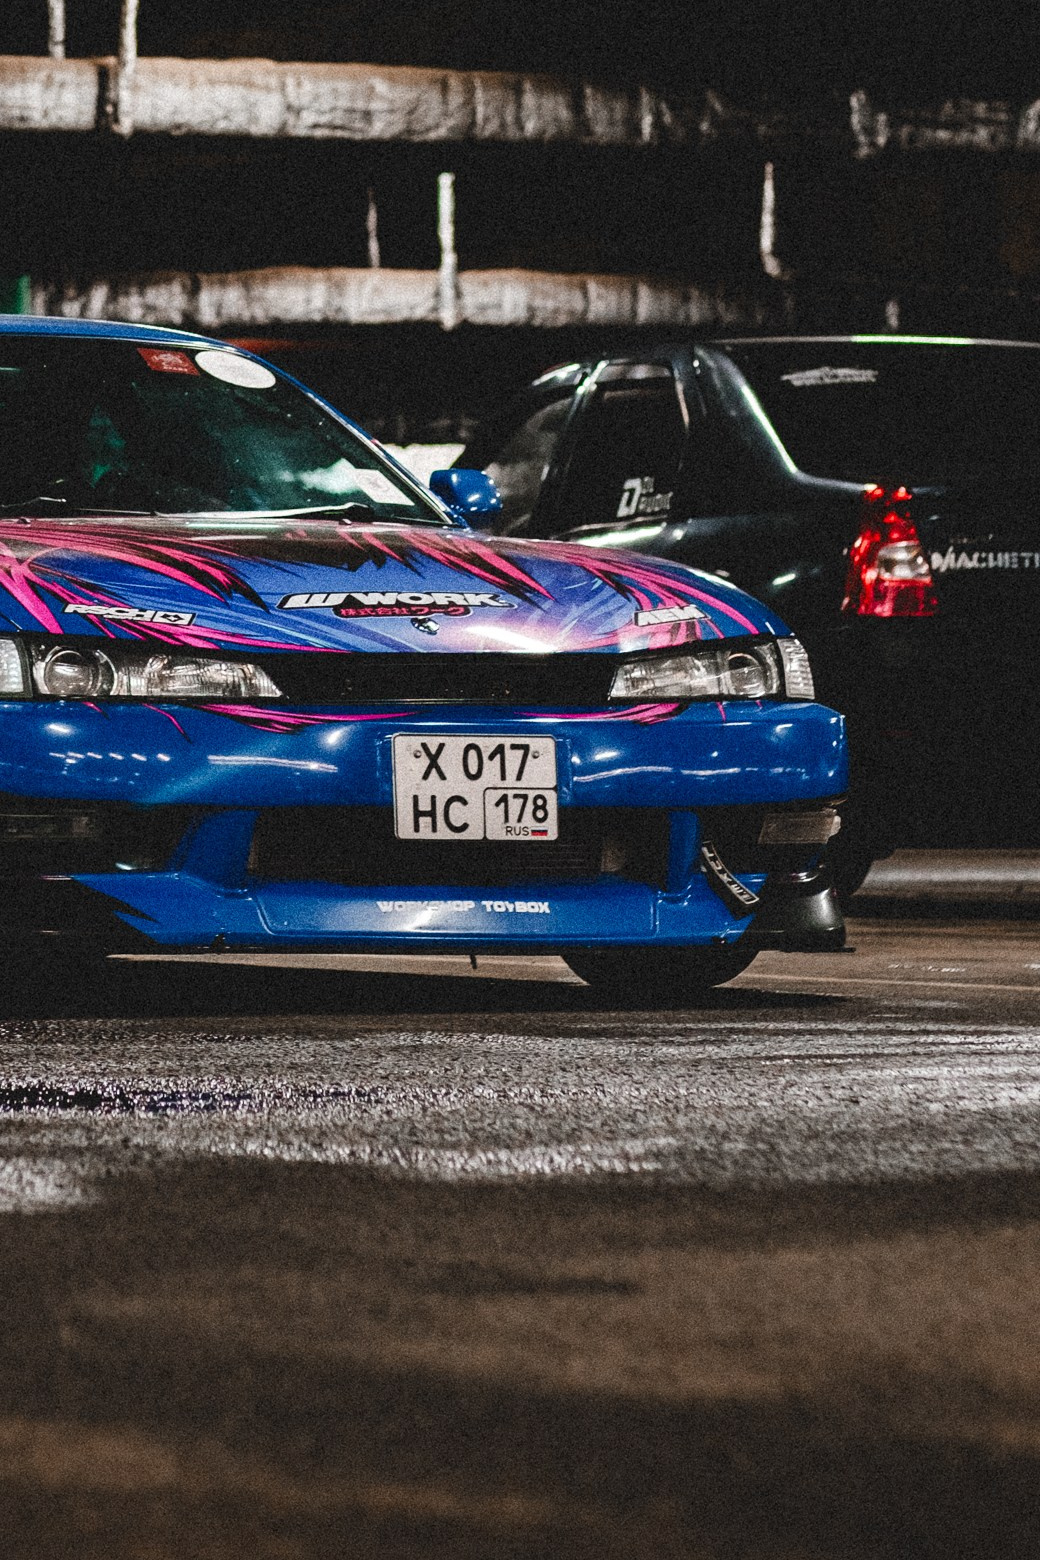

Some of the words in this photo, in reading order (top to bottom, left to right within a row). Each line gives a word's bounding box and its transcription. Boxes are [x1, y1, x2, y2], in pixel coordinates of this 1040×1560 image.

[420, 742, 447, 781] X
[462, 742, 531, 781] 017
[412, 794, 470, 833] HC
[494, 793, 549, 824] 178
[505, 826, 530, 836] RUS
